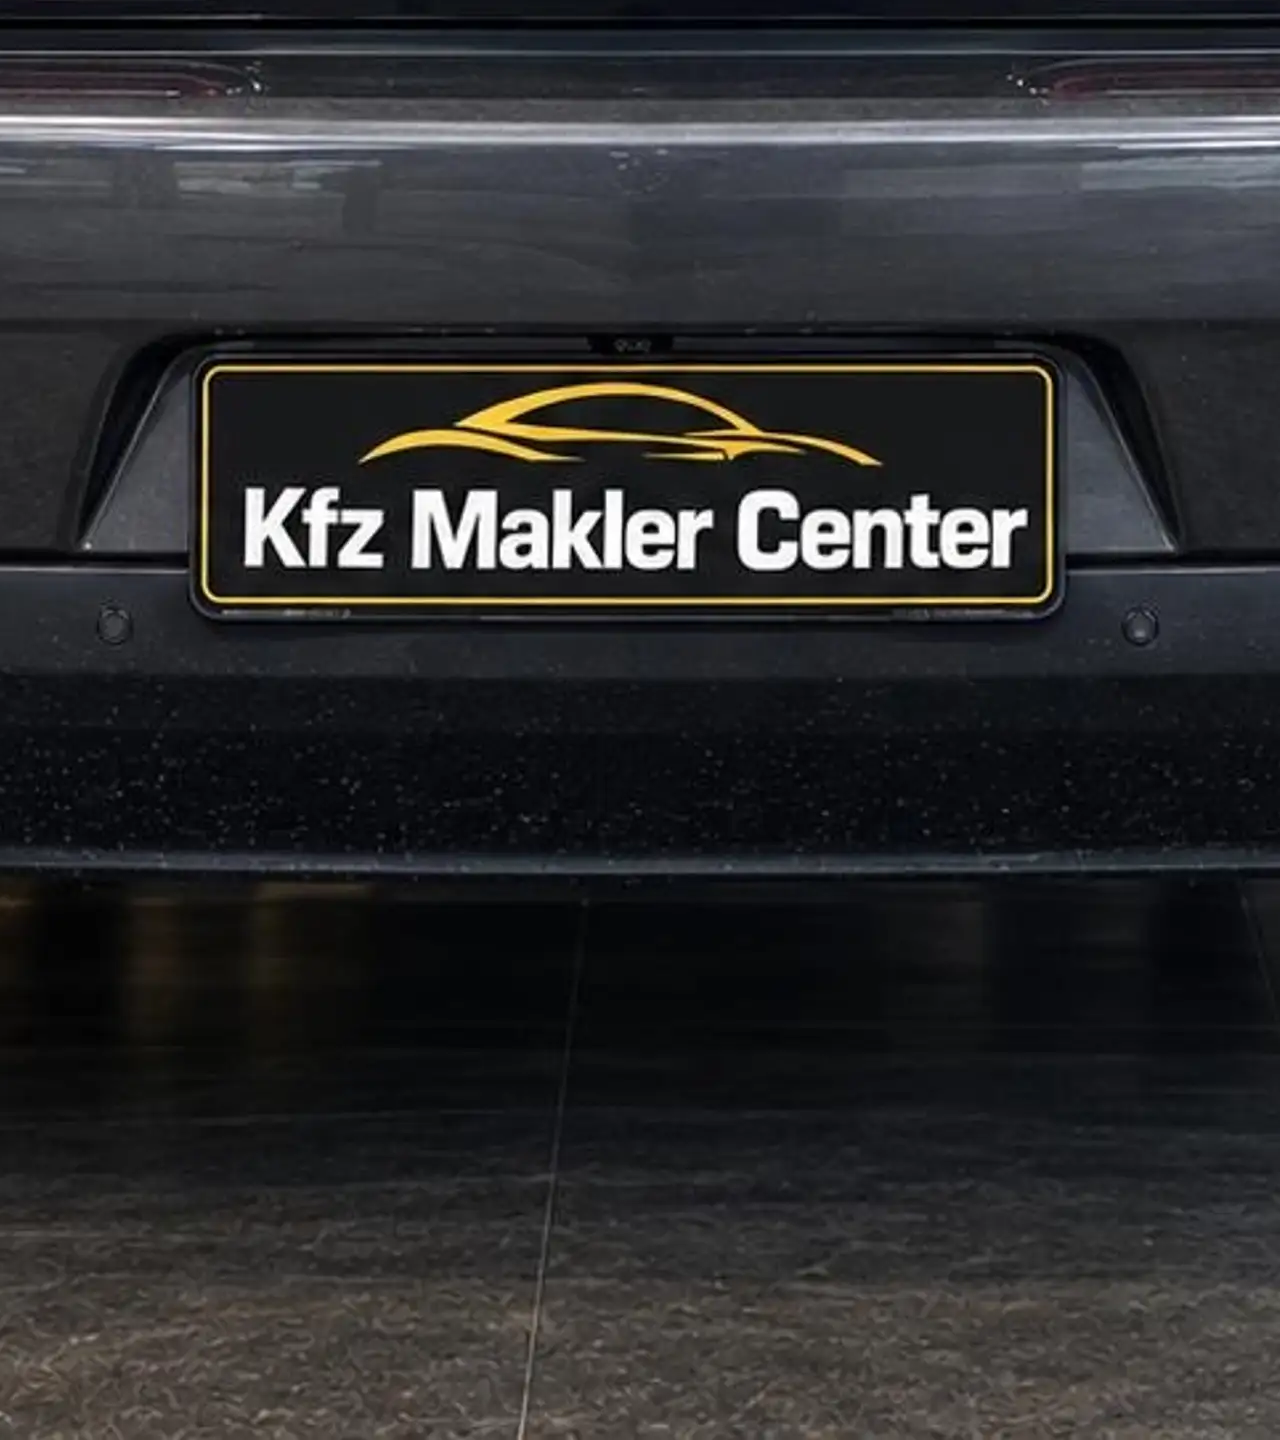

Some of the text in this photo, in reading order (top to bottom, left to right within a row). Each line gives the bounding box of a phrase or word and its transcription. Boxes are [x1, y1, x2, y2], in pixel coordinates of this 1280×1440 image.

[244, 487, 1028, 571] Kfz Makler Center
